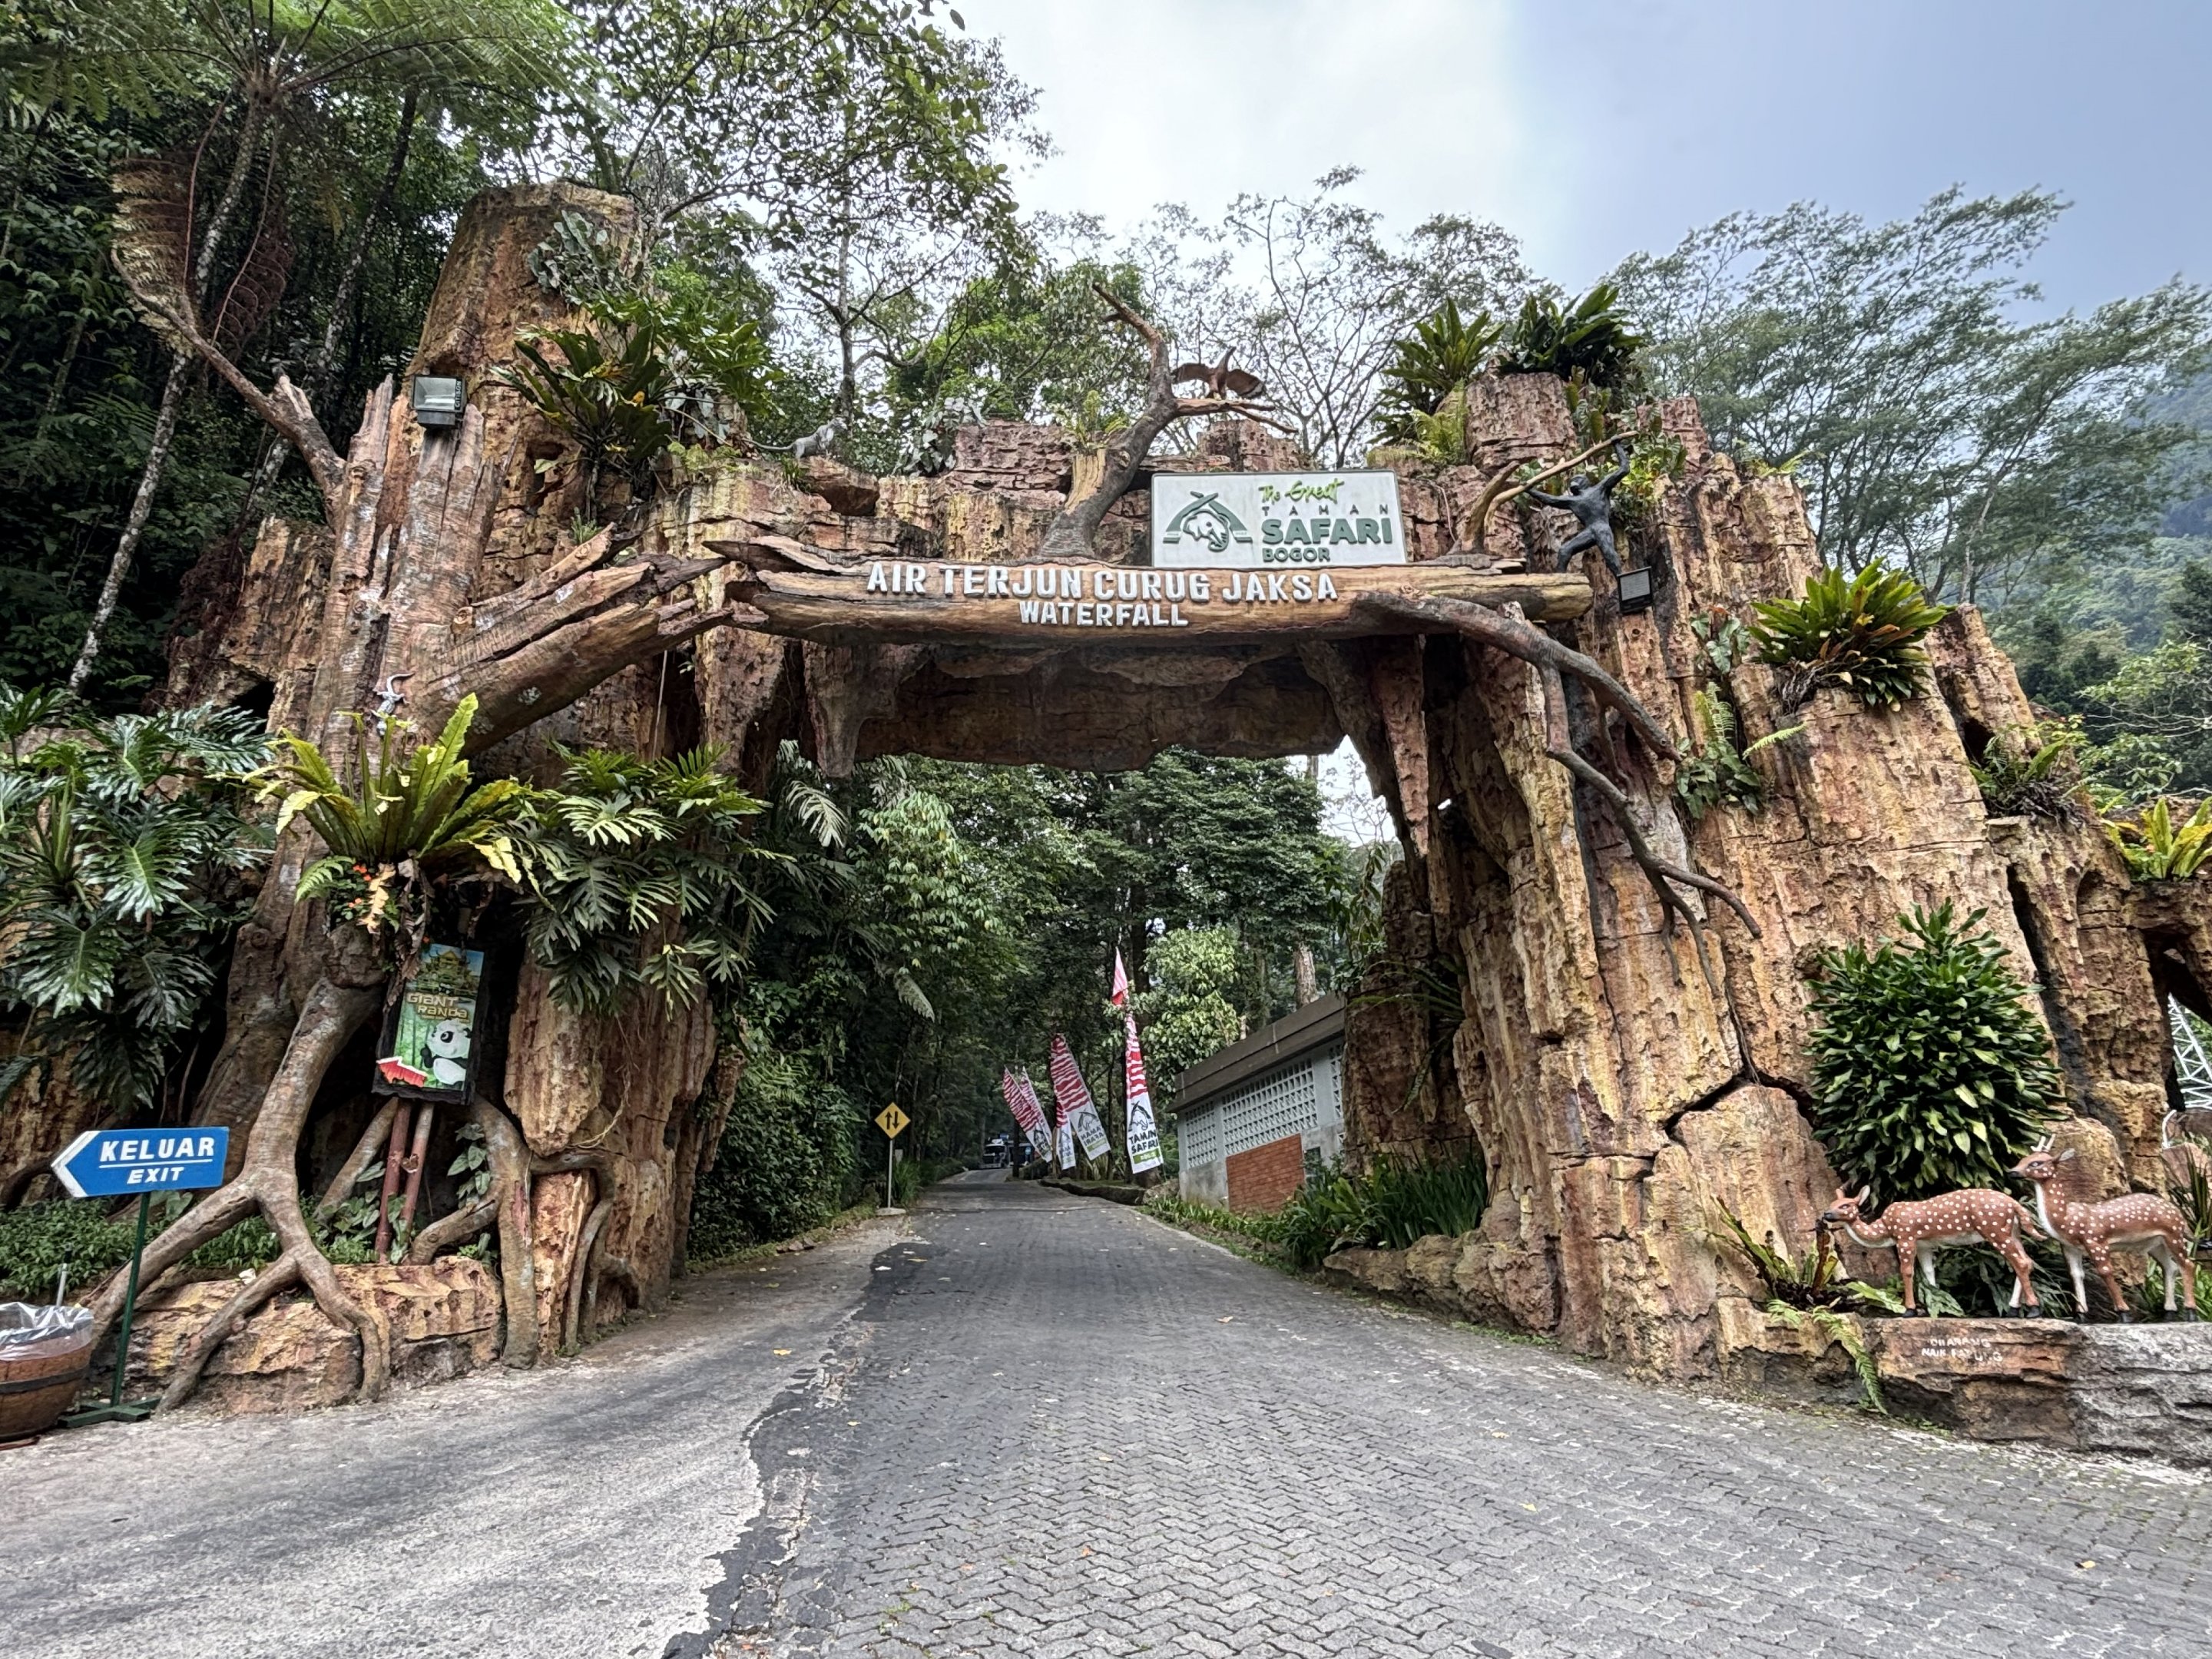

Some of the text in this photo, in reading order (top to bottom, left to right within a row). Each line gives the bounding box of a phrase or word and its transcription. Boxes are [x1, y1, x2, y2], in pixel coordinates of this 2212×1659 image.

[1258, 478, 1345, 504] The Great
[1262, 504, 1389, 517] TAMAN
[1261, 517, 1393, 545] SAFARI
[1262, 547, 1331, 563] BOGOR
[866, 561, 1339, 603] AIR TERJUN CURUG JAKSA
[1019, 600, 1189, 627] WATERFALL
[100, 1137, 215, 1162] KELUAR
[126, 1166, 185, 1185] EXIT
